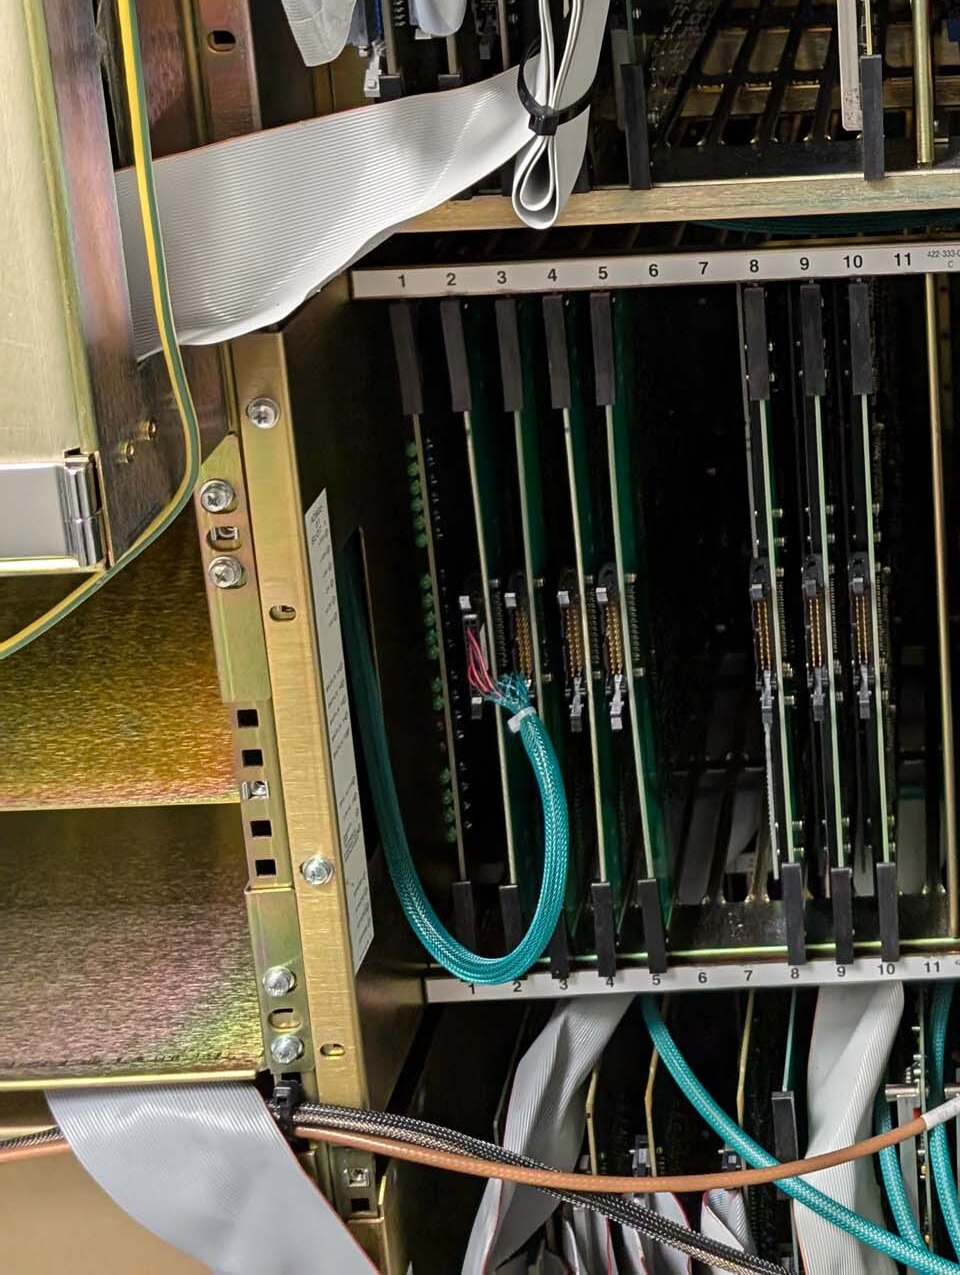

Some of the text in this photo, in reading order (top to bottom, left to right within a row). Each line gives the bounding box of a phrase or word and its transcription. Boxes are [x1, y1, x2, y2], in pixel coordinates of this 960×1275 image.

[397, 275, 406, 288] 1
[446, 273, 457, 287] 2
[496, 271, 508, 285] 3
[547, 269, 558, 282] 4
[598, 267, 609, 280] 5
[648, 264, 659, 278] 6
[698, 262, 709, 275] 7
[749, 260, 760, 273] 8
[799, 257, 810, 271] 9
[843, 255, 863, 269] 10
[893, 253, 911, 267] 11
[468, 983, 475, 995] 1
[512, 981, 522, 993] 2
[560, 978, 568, 990] 3
[606, 976, 614, 988] 4
[652, 974, 660, 986] 5
[697, 972, 708, 984] 6
[743, 970, 753, 982] 7
[790, 968, 800, 980] 8
[836, 965, 848, 978] 9
[878, 964, 895, 975] 10
[924, 962, 940, 974] 11
